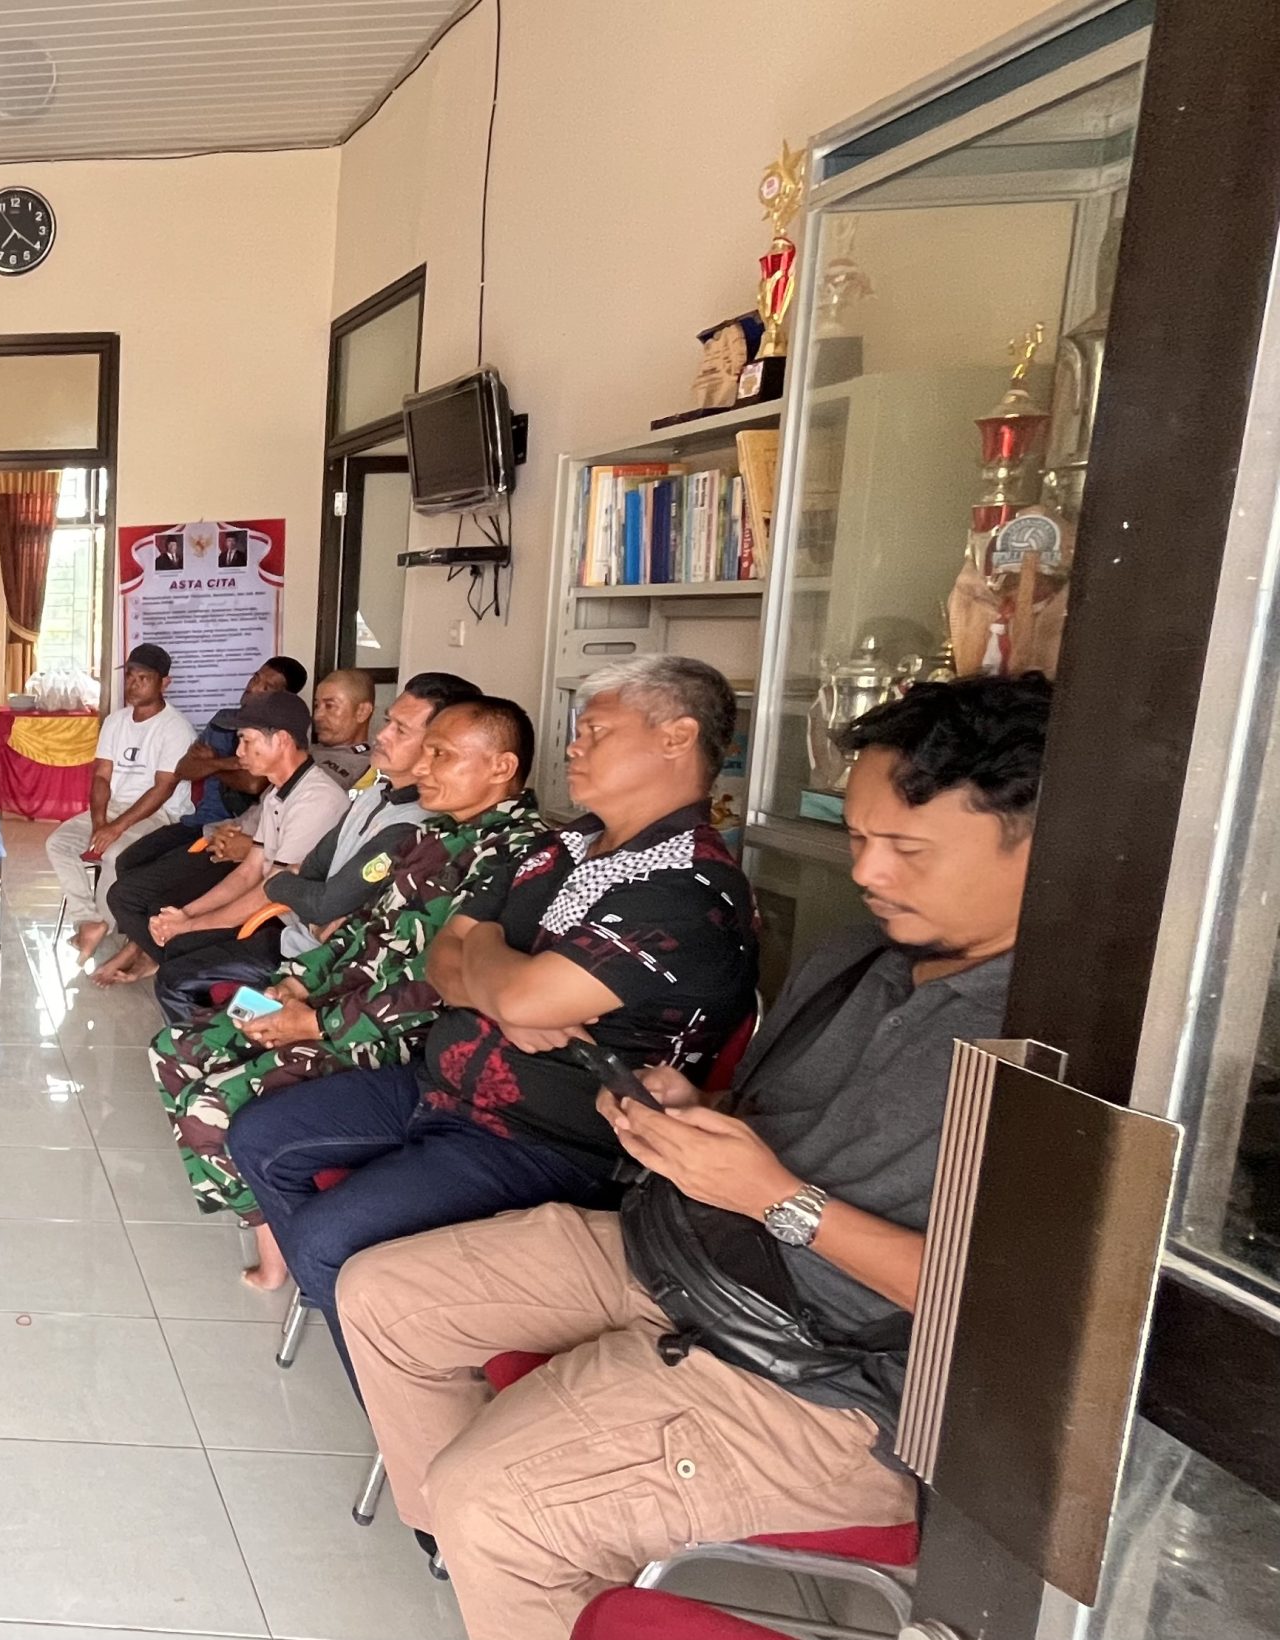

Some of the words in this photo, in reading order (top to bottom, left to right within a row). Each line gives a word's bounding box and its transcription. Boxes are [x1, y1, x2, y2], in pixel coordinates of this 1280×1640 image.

[10, 198, 20, 208] 12
[35, 212, 43, 221] 2
[39, 226, 46, 235] 3
[34, 241, 41, 250] 4
[9, 255, 17, 264] 6
[169, 580, 202, 590] ASTA
[207, 578, 236, 588] CITA
[322, 760, 349, 778] POLRI
